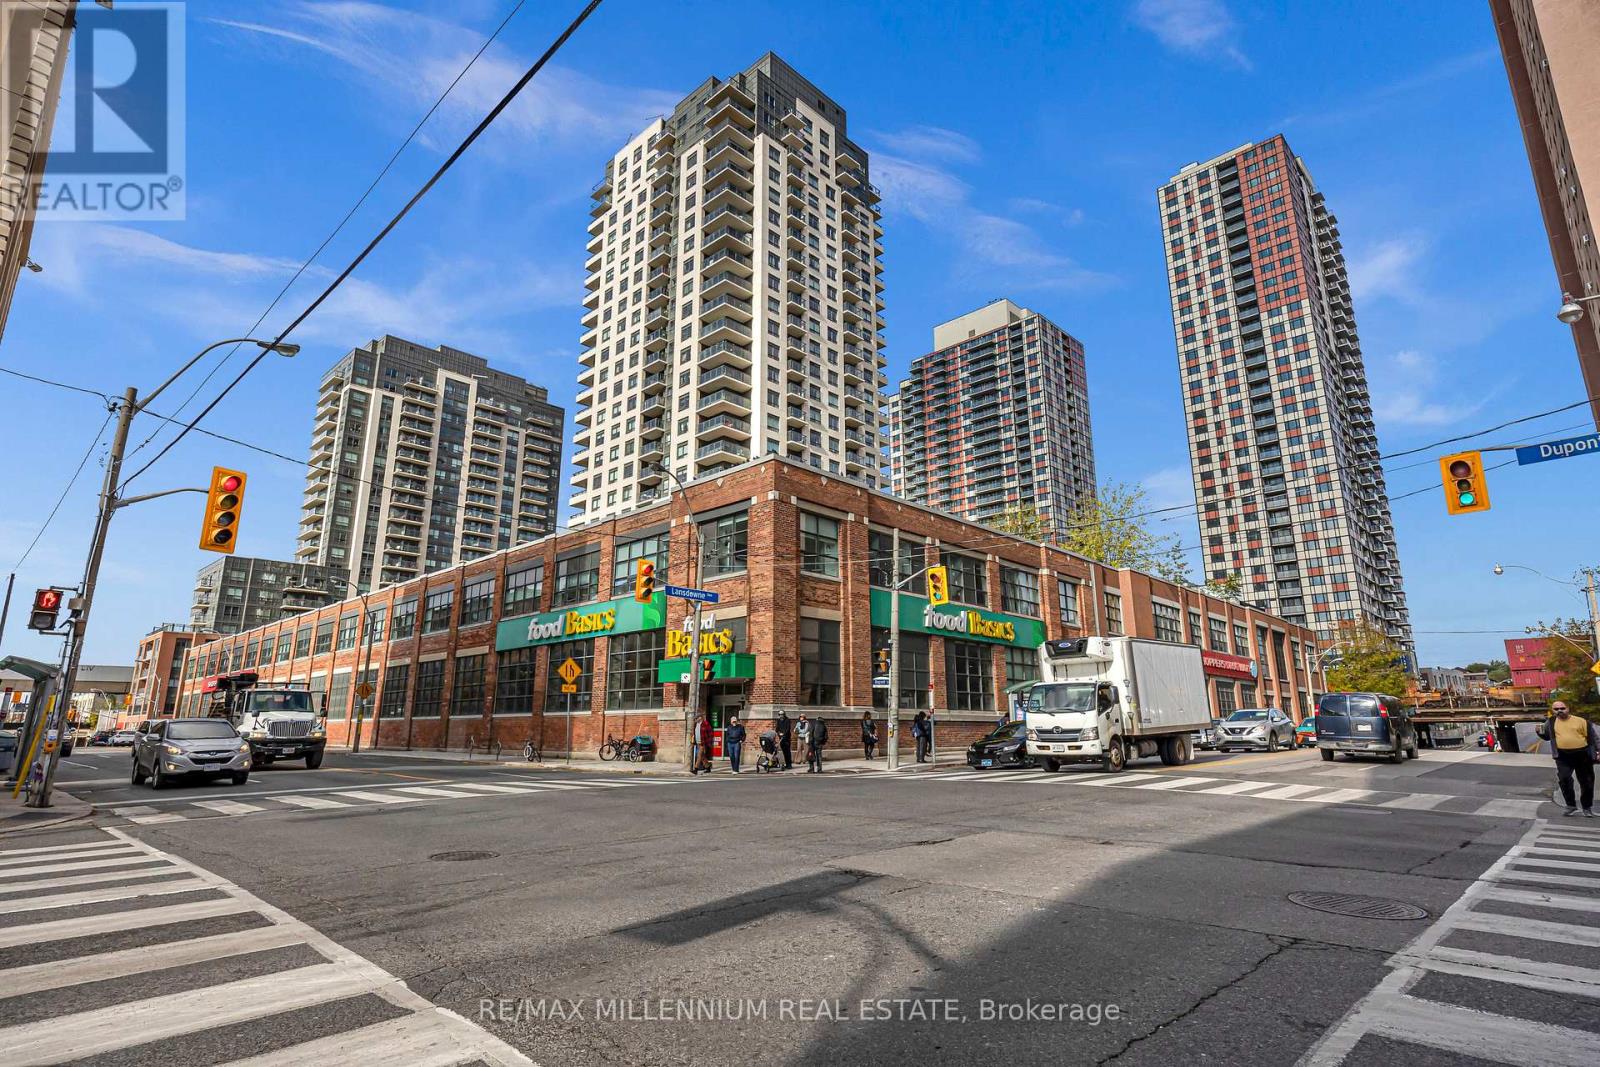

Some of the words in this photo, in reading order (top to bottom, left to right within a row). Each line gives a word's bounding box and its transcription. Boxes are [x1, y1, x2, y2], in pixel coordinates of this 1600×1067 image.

[671, 587, 706, 599] Lansdowne
[527, 614, 565, 640] food
[923, 604, 967, 633] food
[667, 628, 733, 657] Baics
